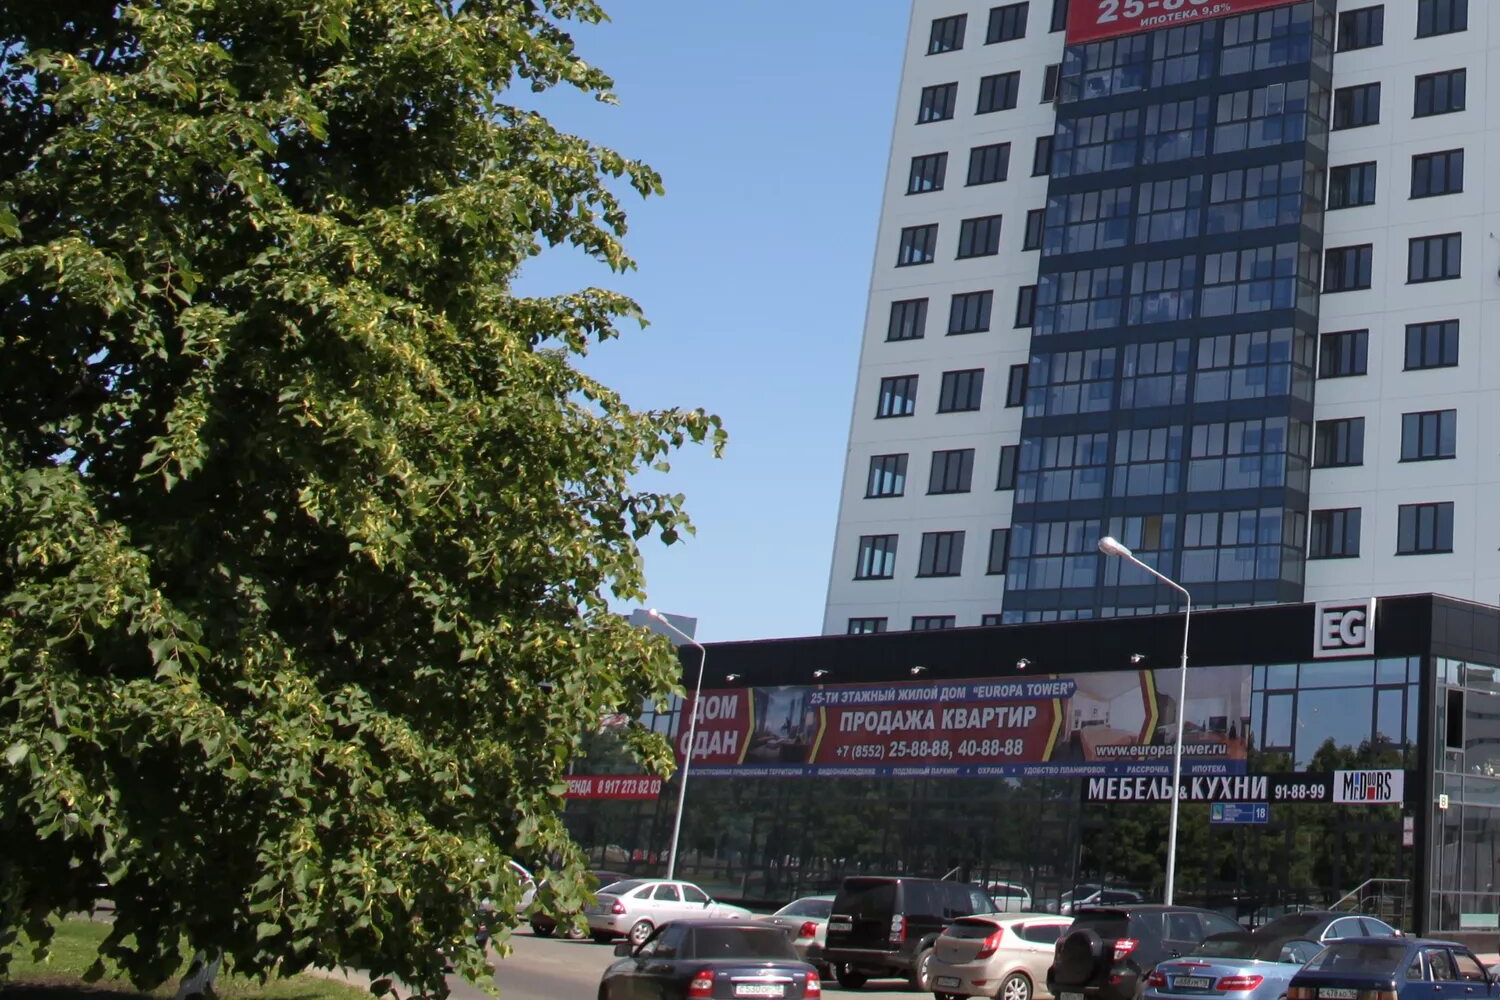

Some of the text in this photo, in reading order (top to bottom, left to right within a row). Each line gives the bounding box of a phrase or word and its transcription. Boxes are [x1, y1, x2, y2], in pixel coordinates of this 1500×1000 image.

[1140, 3, 1231, 27] ИПОТЕКА 9,8%
[1322, 610, 1366, 647] EG
[810, 691, 839, 704] 25-ТИ
[841, 687, 895, 703] ЭТАЖНЫЙ
[897, 685, 938, 701] ЖИЛОЙ
[940, 687, 966, 701] ДОМ
[688, 695, 738, 724] ДОМ
[839, 705, 1037, 734] ПРОДАЖА КВАРТИР
[680, 731, 738, 760] СДАН
[836, 746, 850, 758] +7
[851, 744, 885, 760] (8552)
[957, 739, 1023, 757] 40-88-88
[977, 766, 1004, 775] ОХРАНА
[1023, 766, 1059, 775] УДОБСТВО
[1060, 765, 1106, 774] ПЛАНИРОВОК
[1127, 765, 1169, 774] РАССРОЧКА
[1192, 765, 1227, 773] ИПОТЕКА
[604, 780, 620, 794] 917
[621, 780, 636, 794] 273
[638, 780, 649, 794] 82
[650, 780, 662, 794] 03
[1088, 776, 1268, 800] МЕБЕЛЬ & КУХНИ
[1275, 783, 1326, 799] 91-88-99
[1256, 807, 1266, 819] 18
